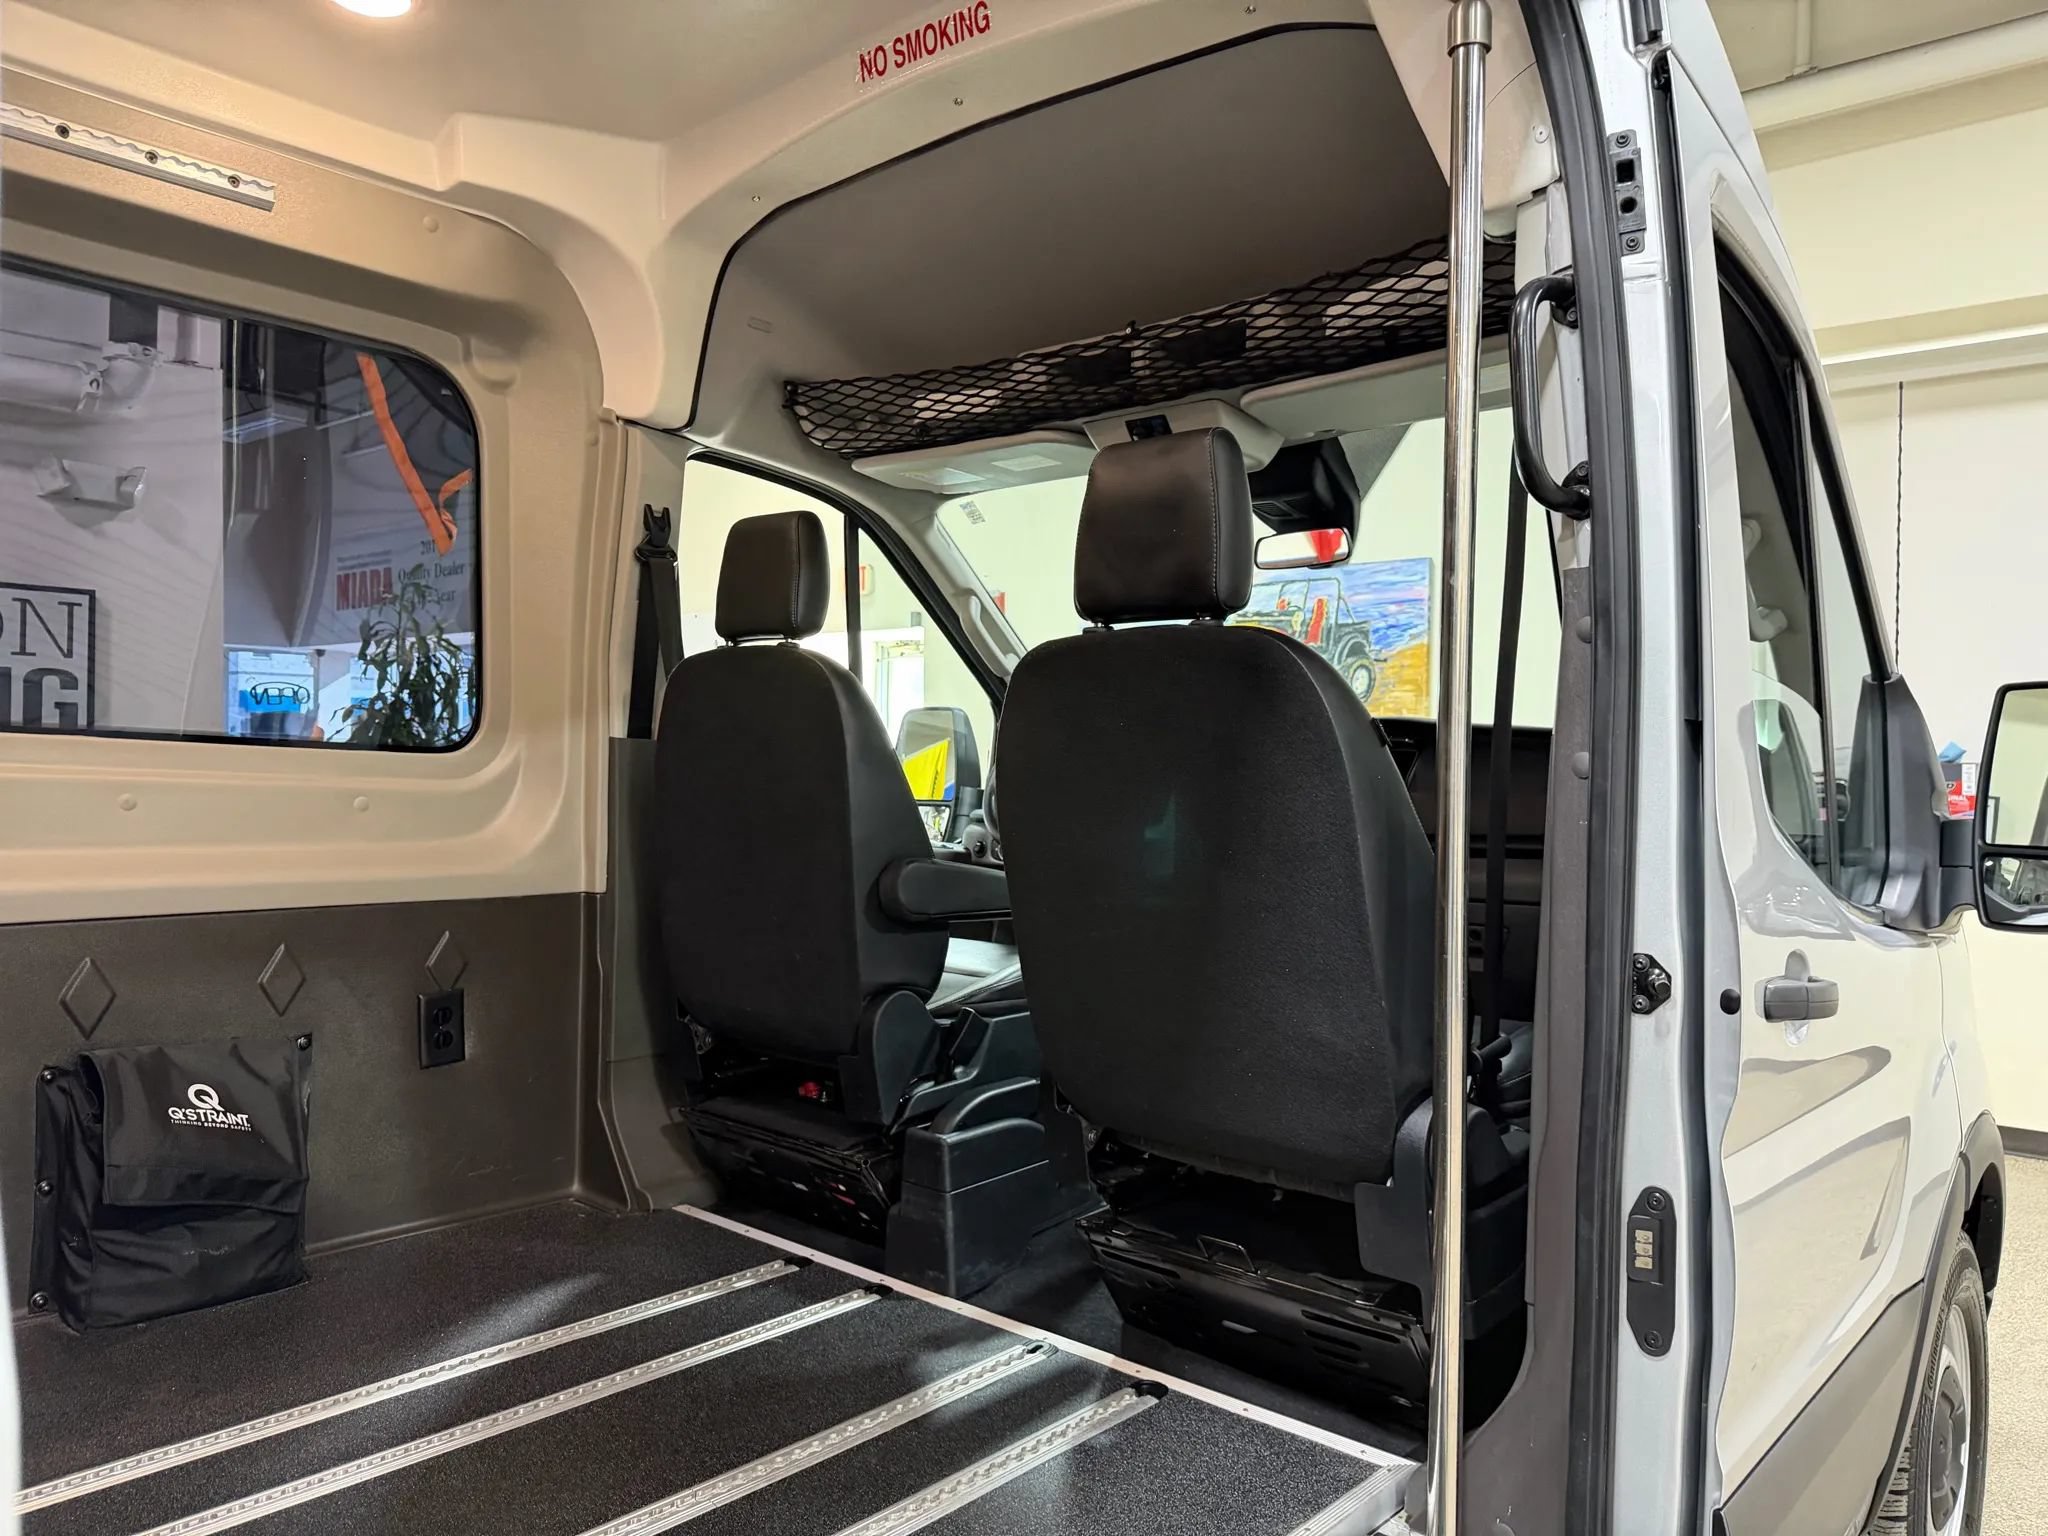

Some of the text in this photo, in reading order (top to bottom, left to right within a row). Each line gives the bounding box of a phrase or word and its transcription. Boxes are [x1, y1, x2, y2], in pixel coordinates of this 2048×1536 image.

[859, 0, 990, 83] NO SMOKING
[435, 561, 464, 578] Dealer
[0, 597, 82, 659] N
[187, 1083, 225, 1111] Q
[168, 1107, 250, 1127] Q'STRAINT
[171, 1119, 202, 1127] THINKING
